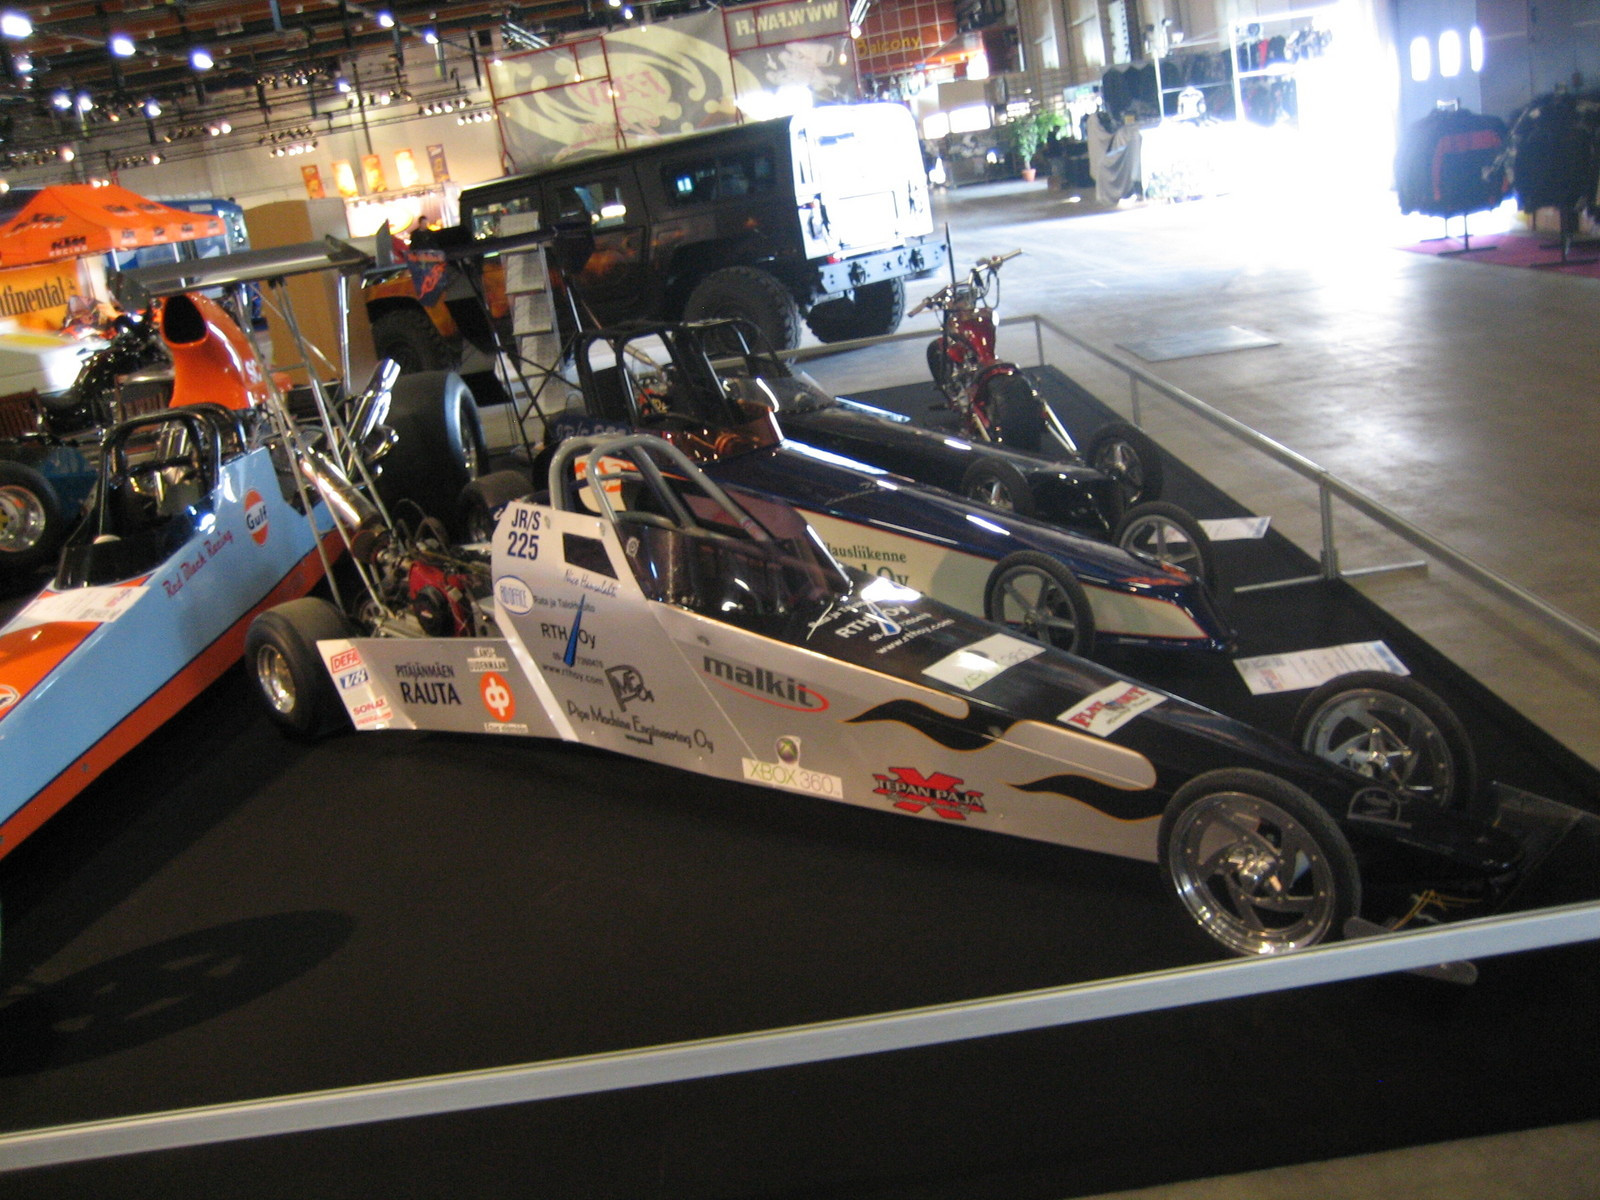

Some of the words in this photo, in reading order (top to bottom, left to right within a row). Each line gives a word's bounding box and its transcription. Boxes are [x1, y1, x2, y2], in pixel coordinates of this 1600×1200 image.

[856, 35, 921, 57] Balcony
[245, 506, 269, 532] Gulf
[511, 508, 541, 530] JR/S
[507, 531, 540, 560] 225
[541, 623, 568, 641] RTH
[578, 629, 596, 649] Oy
[333, 651, 359, 669] DEFA
[400, 682, 461, 706] RAUTA
[703, 655, 814, 709] malkit
[693, 729, 714, 753] Oy
[749, 761, 797, 786] XBOX
[799, 773, 834, 795] 360
